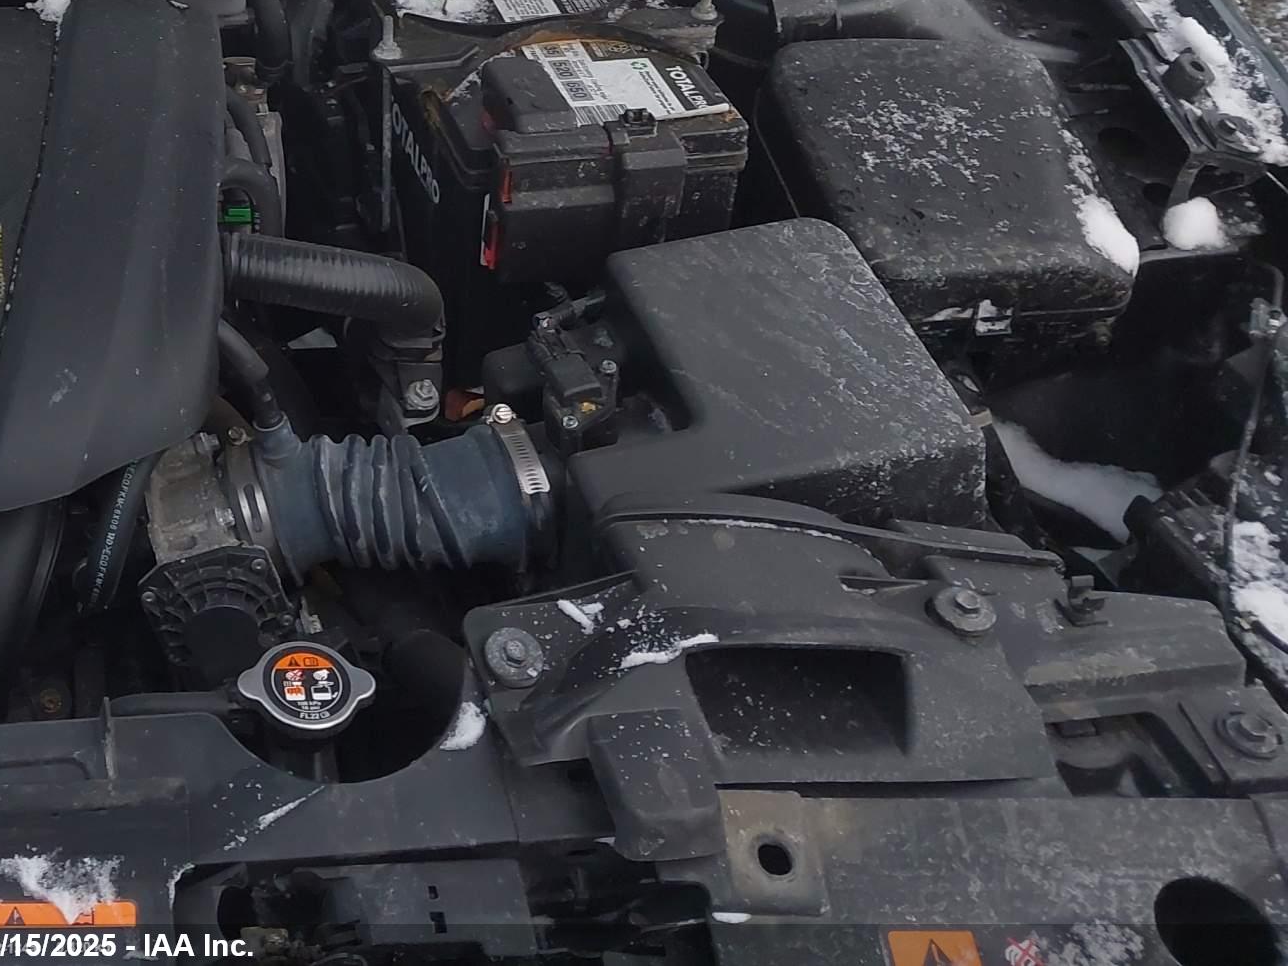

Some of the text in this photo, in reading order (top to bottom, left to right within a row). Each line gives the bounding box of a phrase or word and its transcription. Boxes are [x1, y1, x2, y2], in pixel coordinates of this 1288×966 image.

[553, 61, 573, 78] 520
[567, 81, 588, 99] 650
[391, 100, 441, 204] OTALPRO
